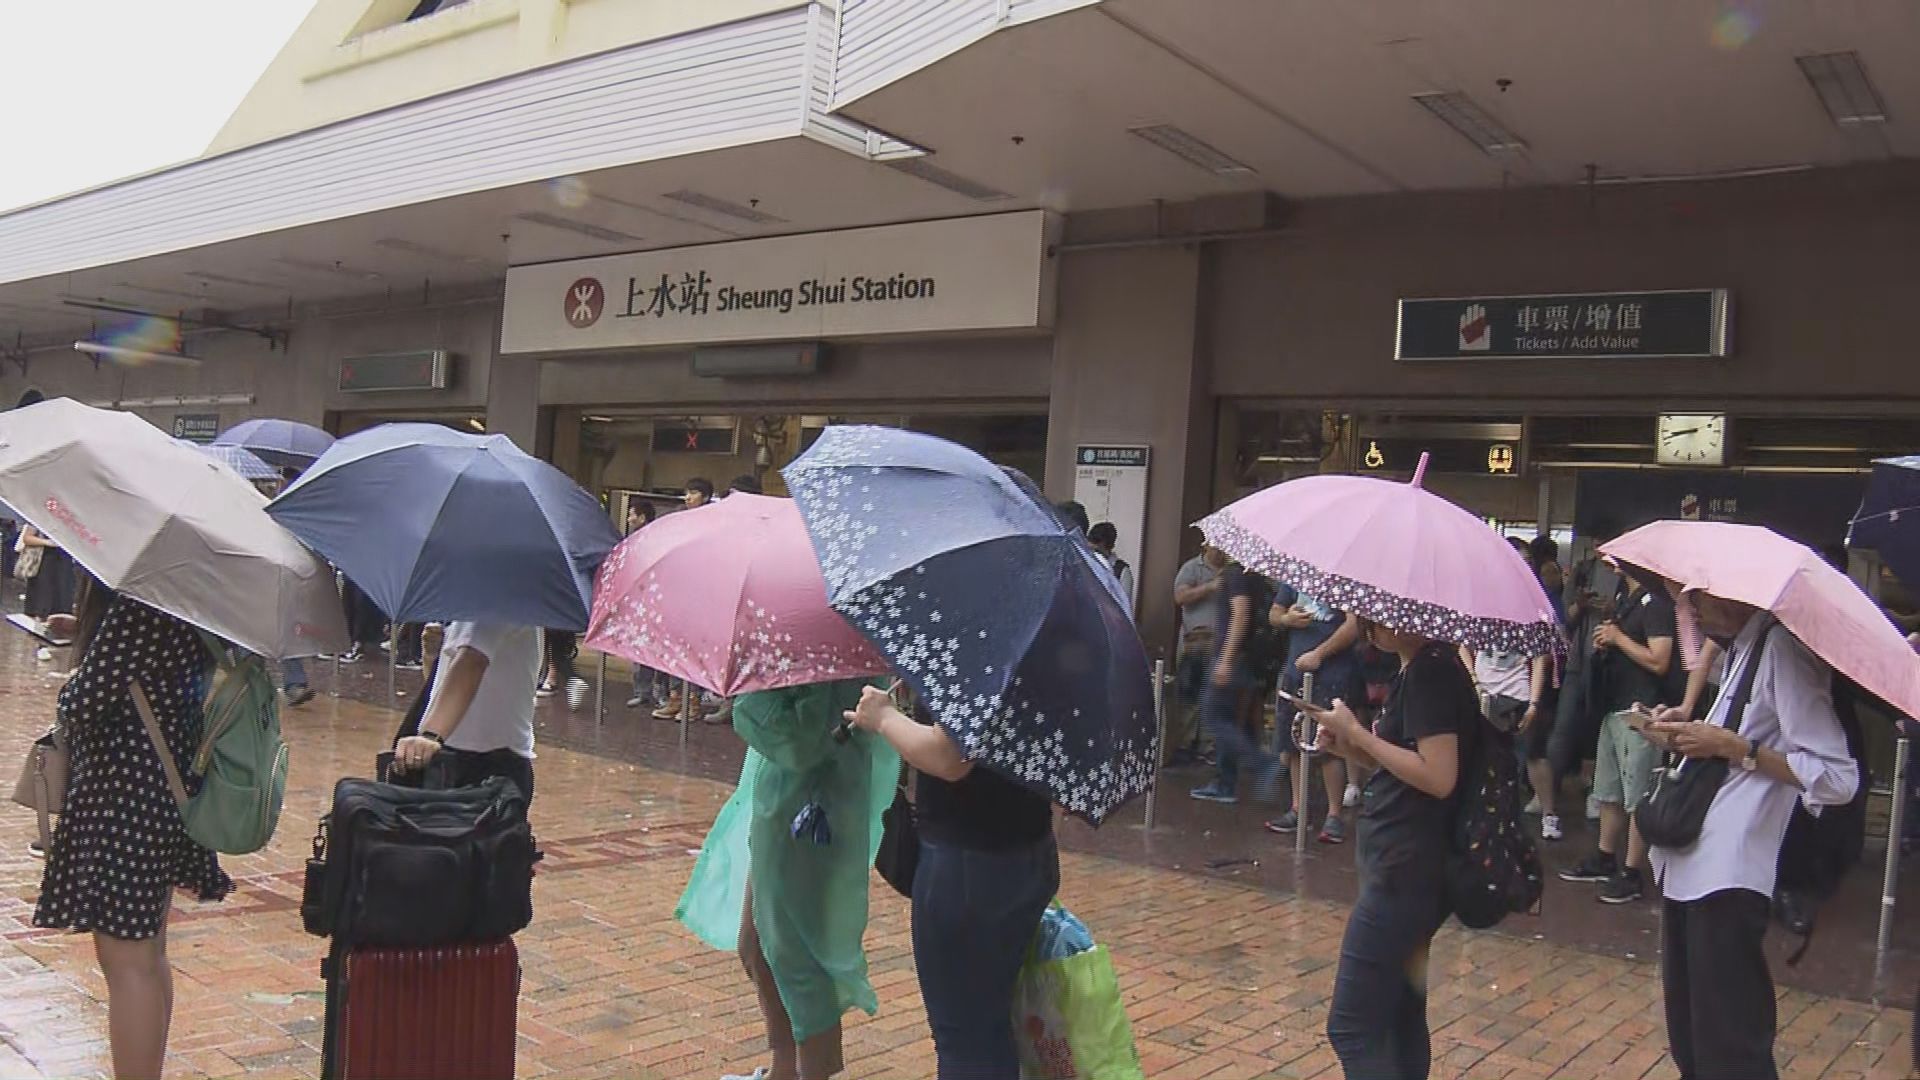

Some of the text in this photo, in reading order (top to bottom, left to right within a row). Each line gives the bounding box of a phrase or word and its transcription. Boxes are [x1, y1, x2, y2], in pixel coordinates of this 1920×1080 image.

[616, 270, 712, 318] 上水站
[716, 272, 935, 313] Sheung Shui Station
[1515, 337, 1560, 350] Tickets
[1570, 336, 1599, 349] Add
[1600, 336, 1640, 349] Value
